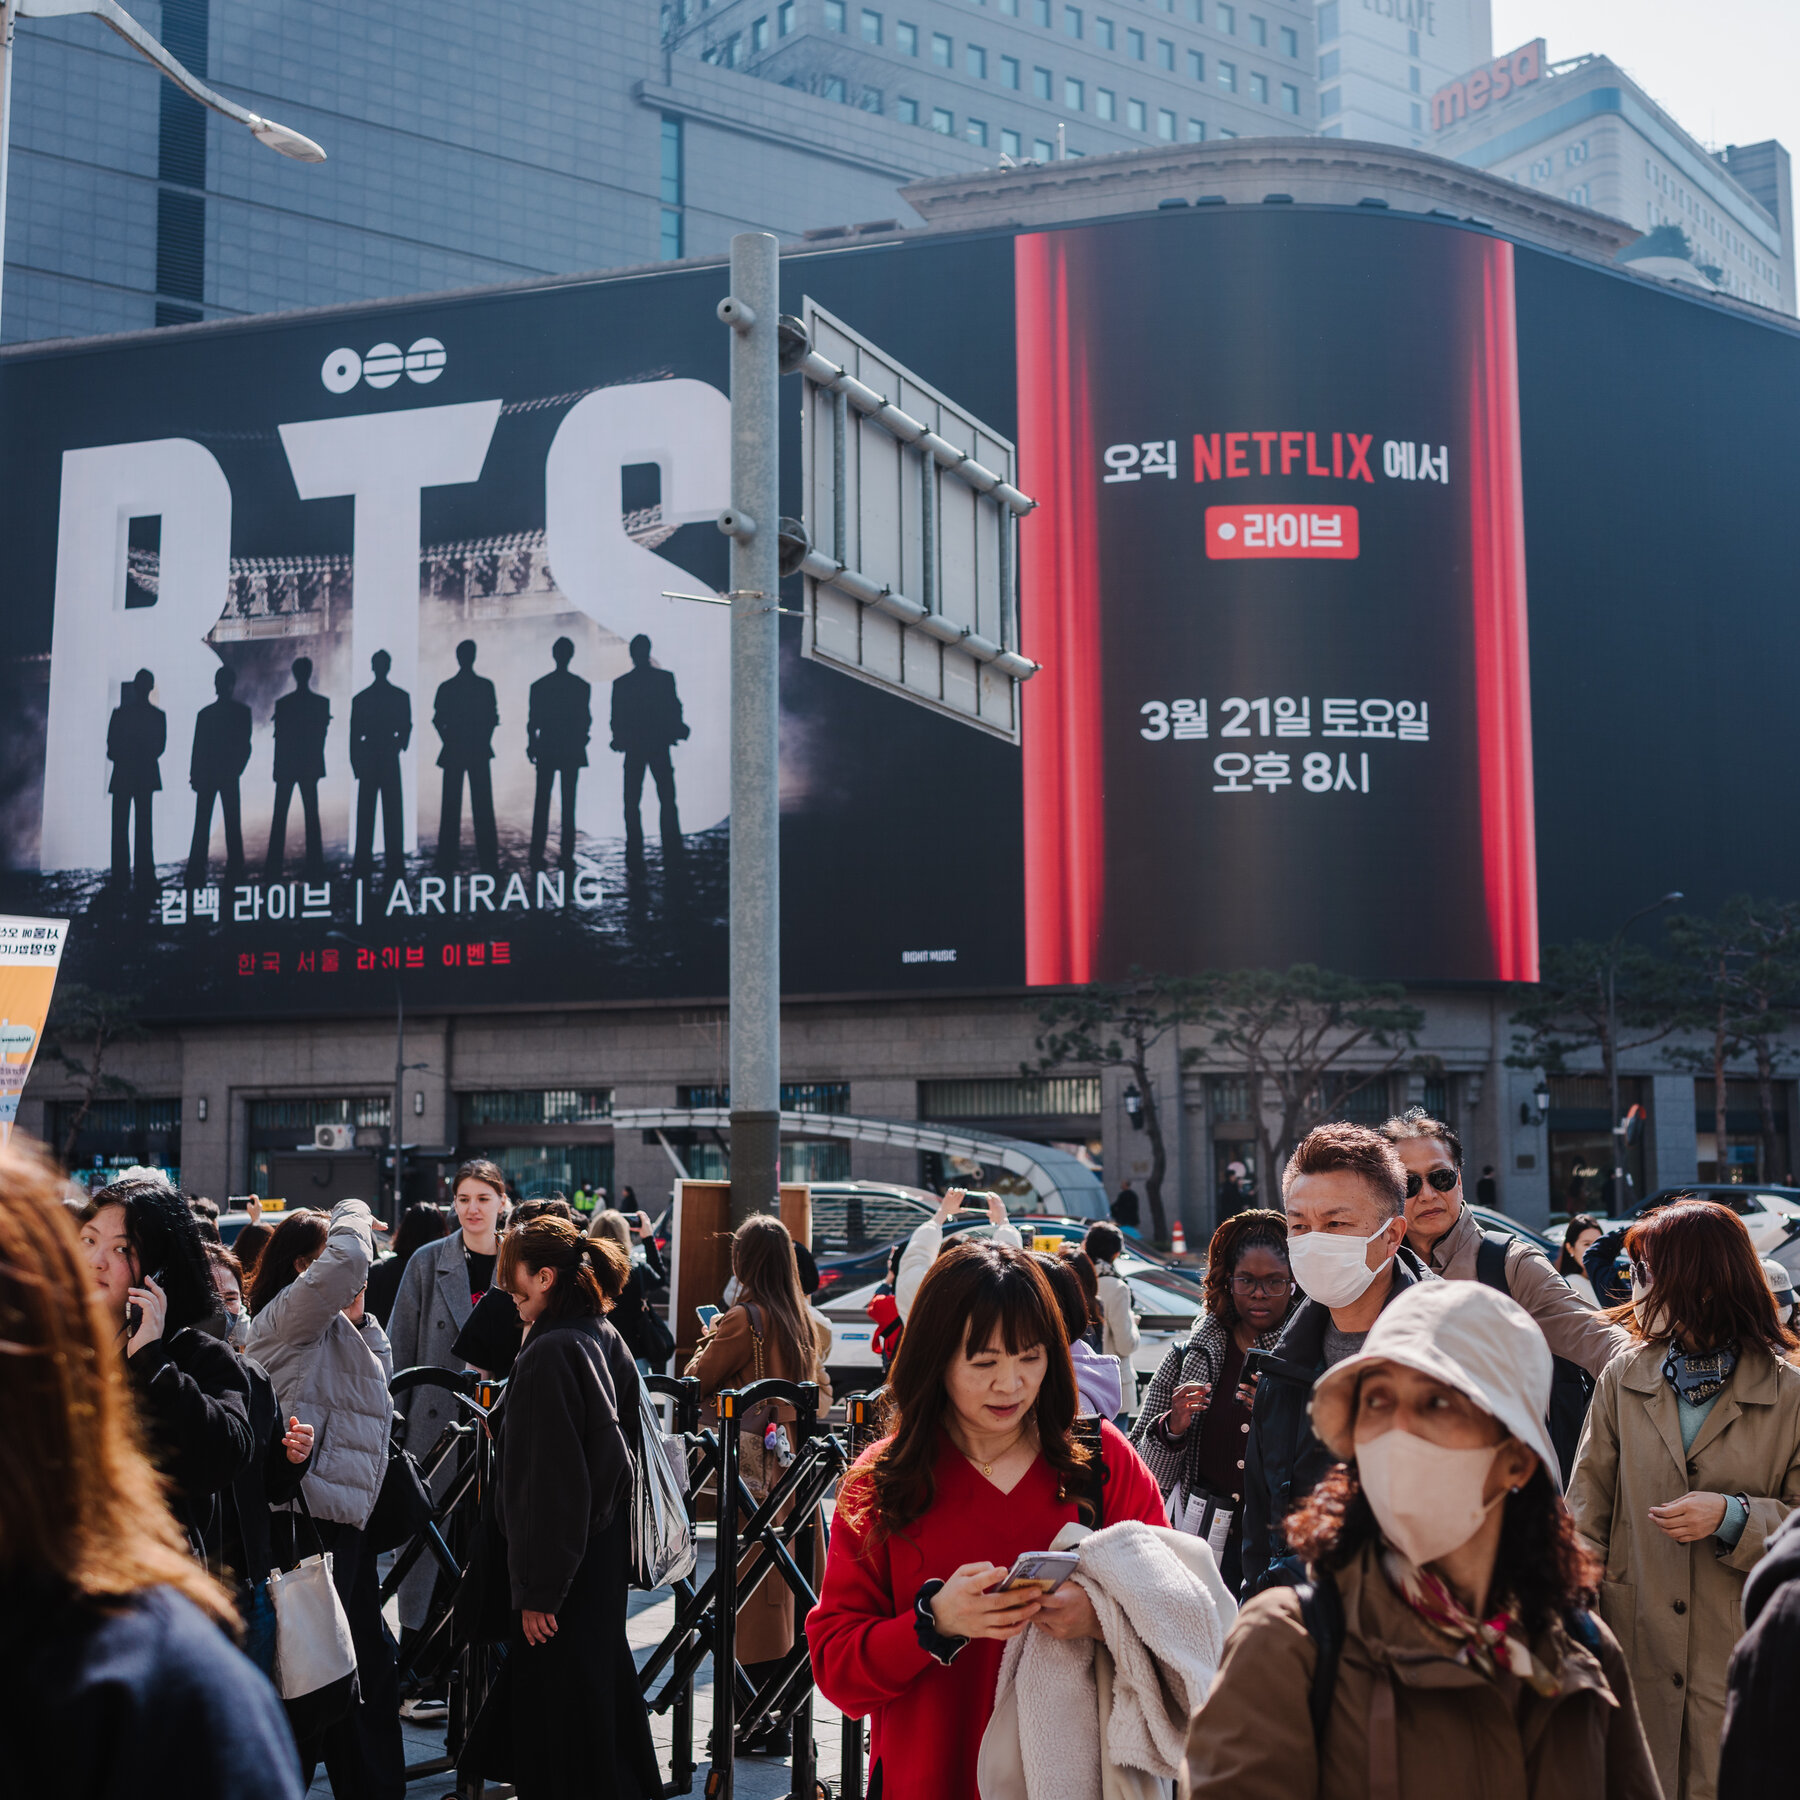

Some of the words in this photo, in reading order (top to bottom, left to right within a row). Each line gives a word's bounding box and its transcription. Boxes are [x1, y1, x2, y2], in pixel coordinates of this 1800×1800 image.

[1431, 40, 1541, 131] mesa
[1103, 439, 1178, 483] 오직
[1192, 431, 1375, 484] NETFLIX
[1383, 440, 1450, 484] 에서
[1243, 513, 1344, 548] 라이브
[40, 377, 731, 872] BTS
[1140, 698, 1210, 741] 3월
[1220, 696, 1312, 738] 21일
[1321, 698, 1430, 742] 토요일
[1213, 750, 1293, 794] 오후
[1301, 752, 1370, 794] 8시
[161, 886, 221, 925] 컴백
[233, 881, 332, 921] 라이브
[384, 868, 605, 917] ARIRANG
[238, 951, 281, 976] 한국
[297, 949, 340, 973] 서울
[356, 945, 426, 970] 라이브
[441, 941, 512, 967] 이벤트
